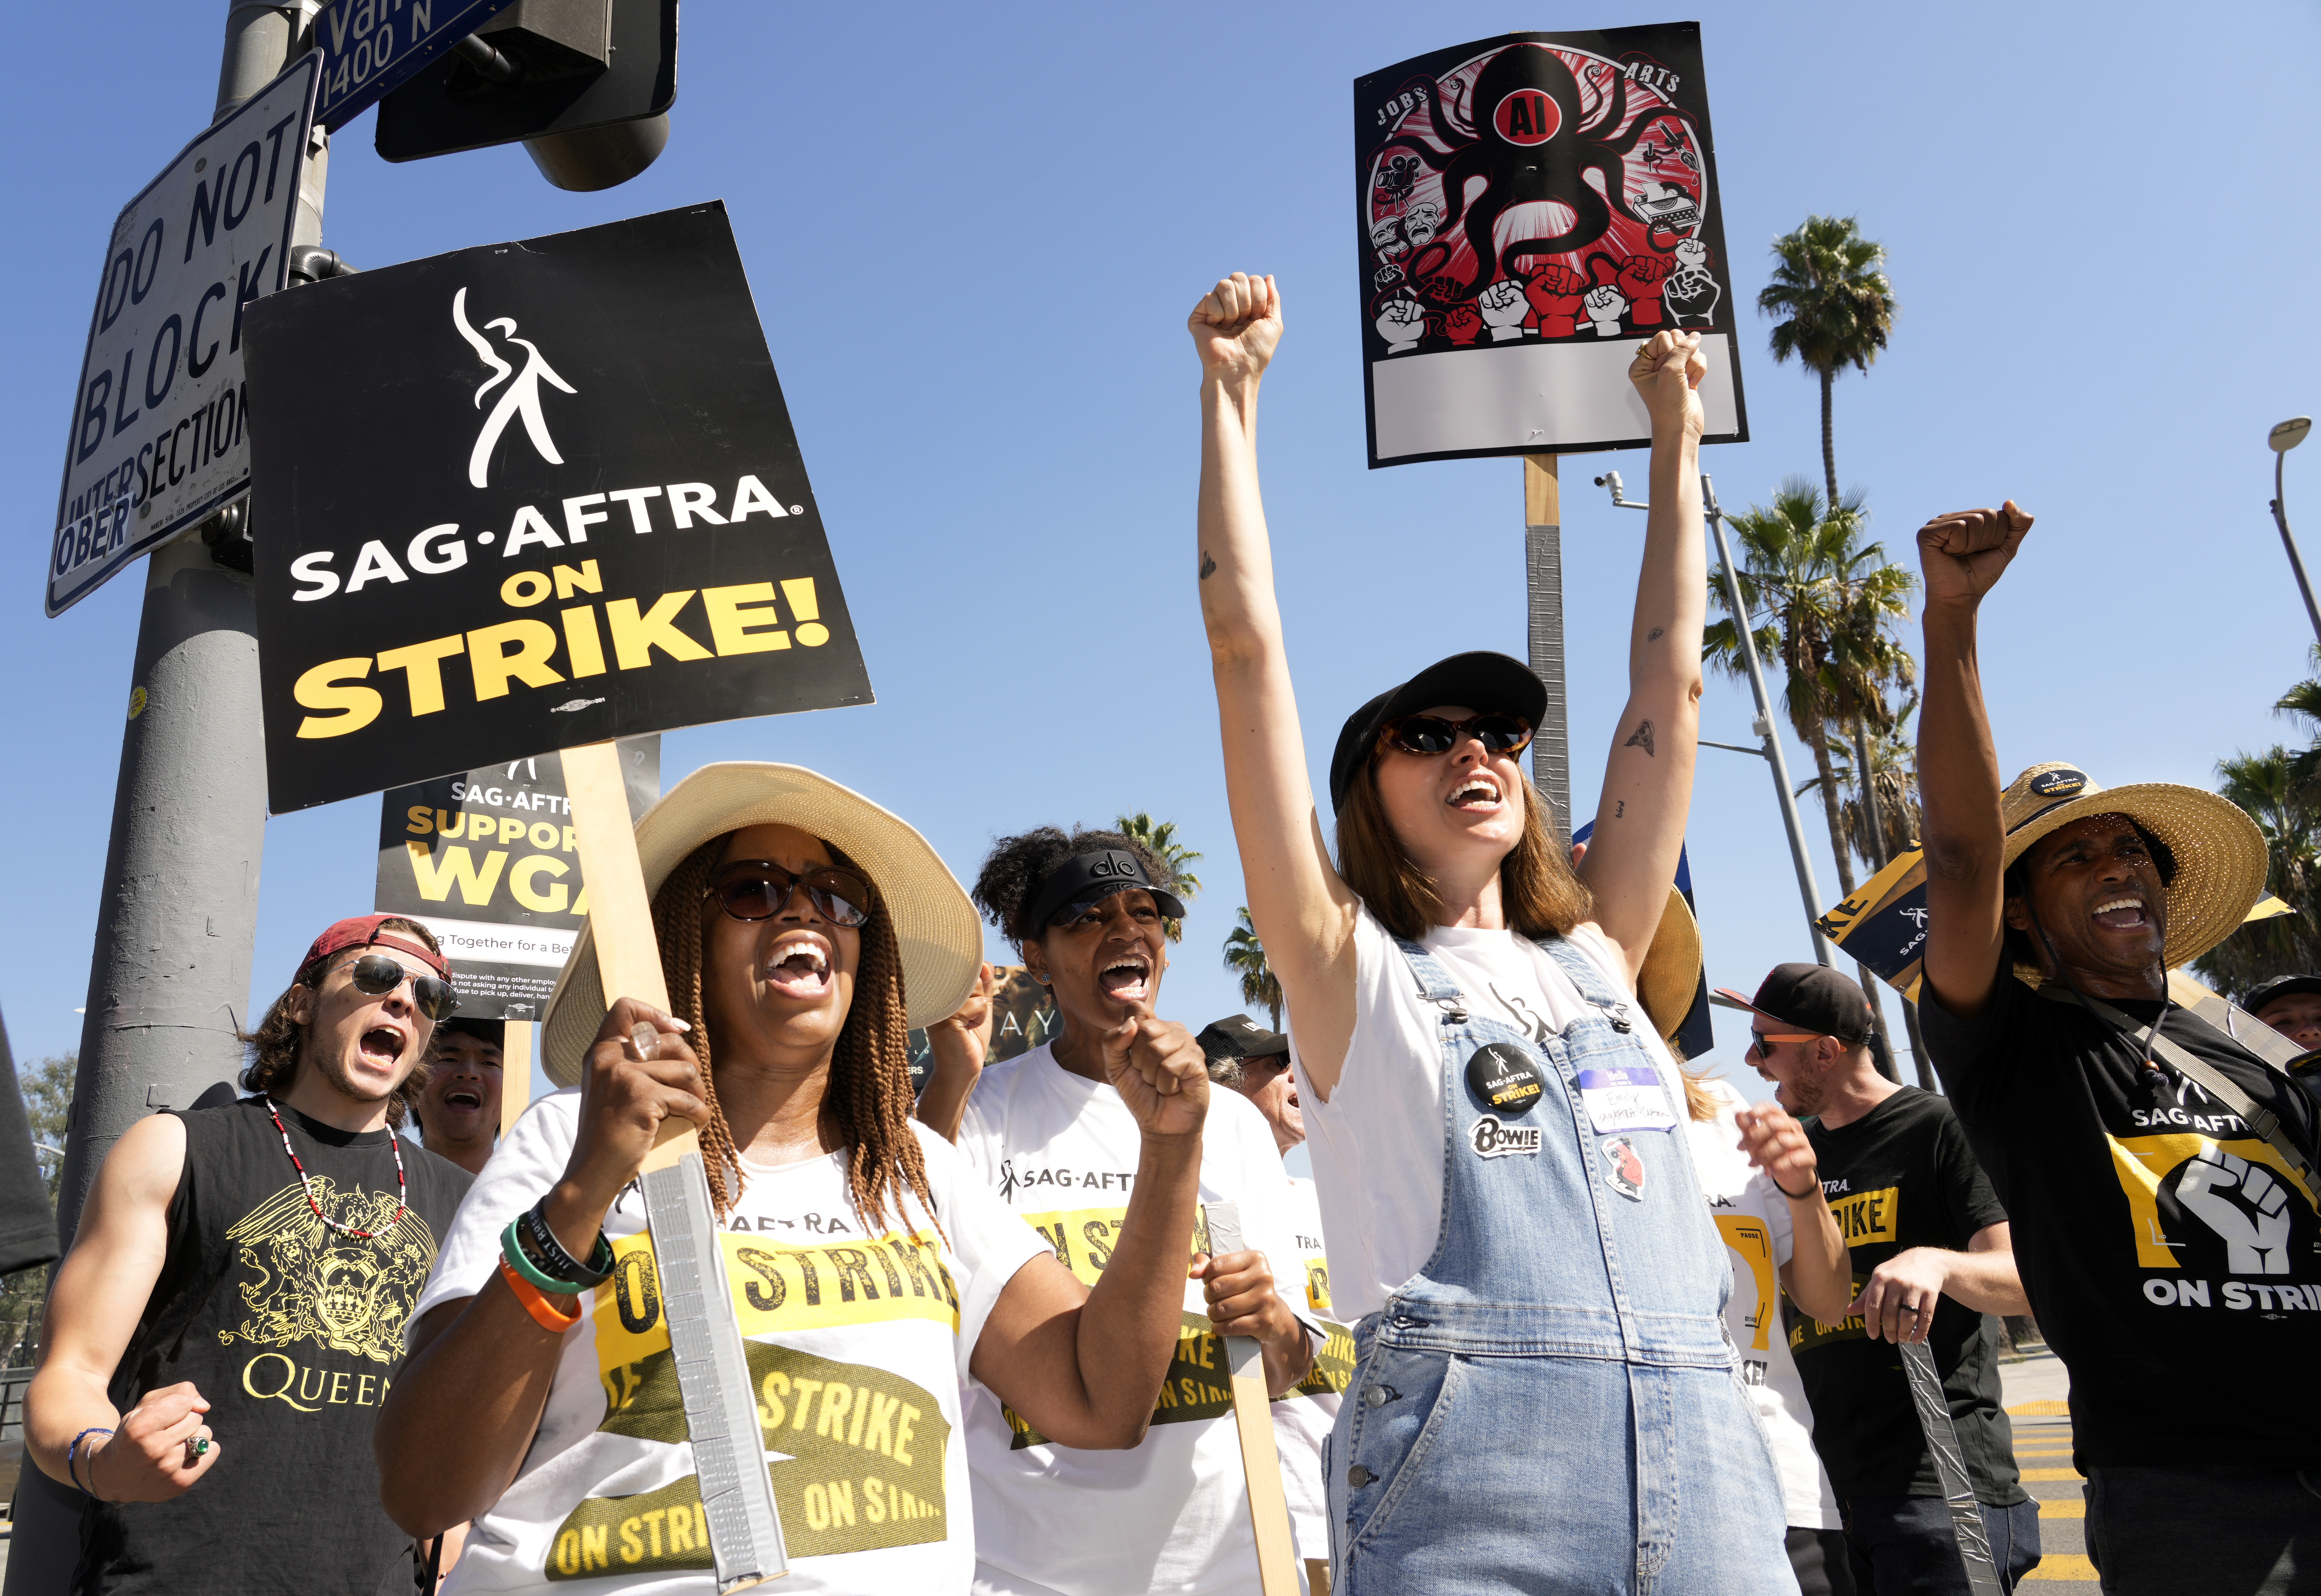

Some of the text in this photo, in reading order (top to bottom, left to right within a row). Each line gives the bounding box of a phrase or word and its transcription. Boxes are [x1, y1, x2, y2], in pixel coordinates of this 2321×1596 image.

[323, 0, 431, 108] 1400 N
[1623, 62, 1680, 93] ARTS
[1378, 87, 1428, 125] JOBS
[1509, 96, 1546, 136] AI
[100, 110, 296, 336] DO NOT
[77, 243, 273, 467] BLOCK
[150, 519, 163, 531] MANERI
[165, 515, 174, 523] 5/06
[176, 508, 185, 517] 1326
[186, 495, 203, 511] PROPERTY
[213, 486, 218, 494] OF
[226, 476, 241, 487] ANGE
[56, 497, 129, 575] OBER
[500, 559, 603, 607] ON
[294, 577, 830, 739] STRIKE!
[2044, 782, 2082, 793] STRIKE!
[1092, 852, 1136, 876] alo
[450, 934, 513, 949] Together
[517, 940, 536, 951] for
[451, 972, 477, 981] dispute
[512, 983, 547, 992] individual
[510, 991, 535, 999] deliver,
[1606, 1070, 1628, 1081] Hello
[1492, 1083, 1541, 1105] STRIKE!
[1606, 1090, 1641, 1114] Emily
[1642, 1107, 1670, 1121] Captain
[2143, 1279, 2321, 1310] ON STRI
[758, 1371, 921, 1466] STRIKE
[557, 1525, 608, 1574] ON
[804, 1481, 856, 1531] ON
